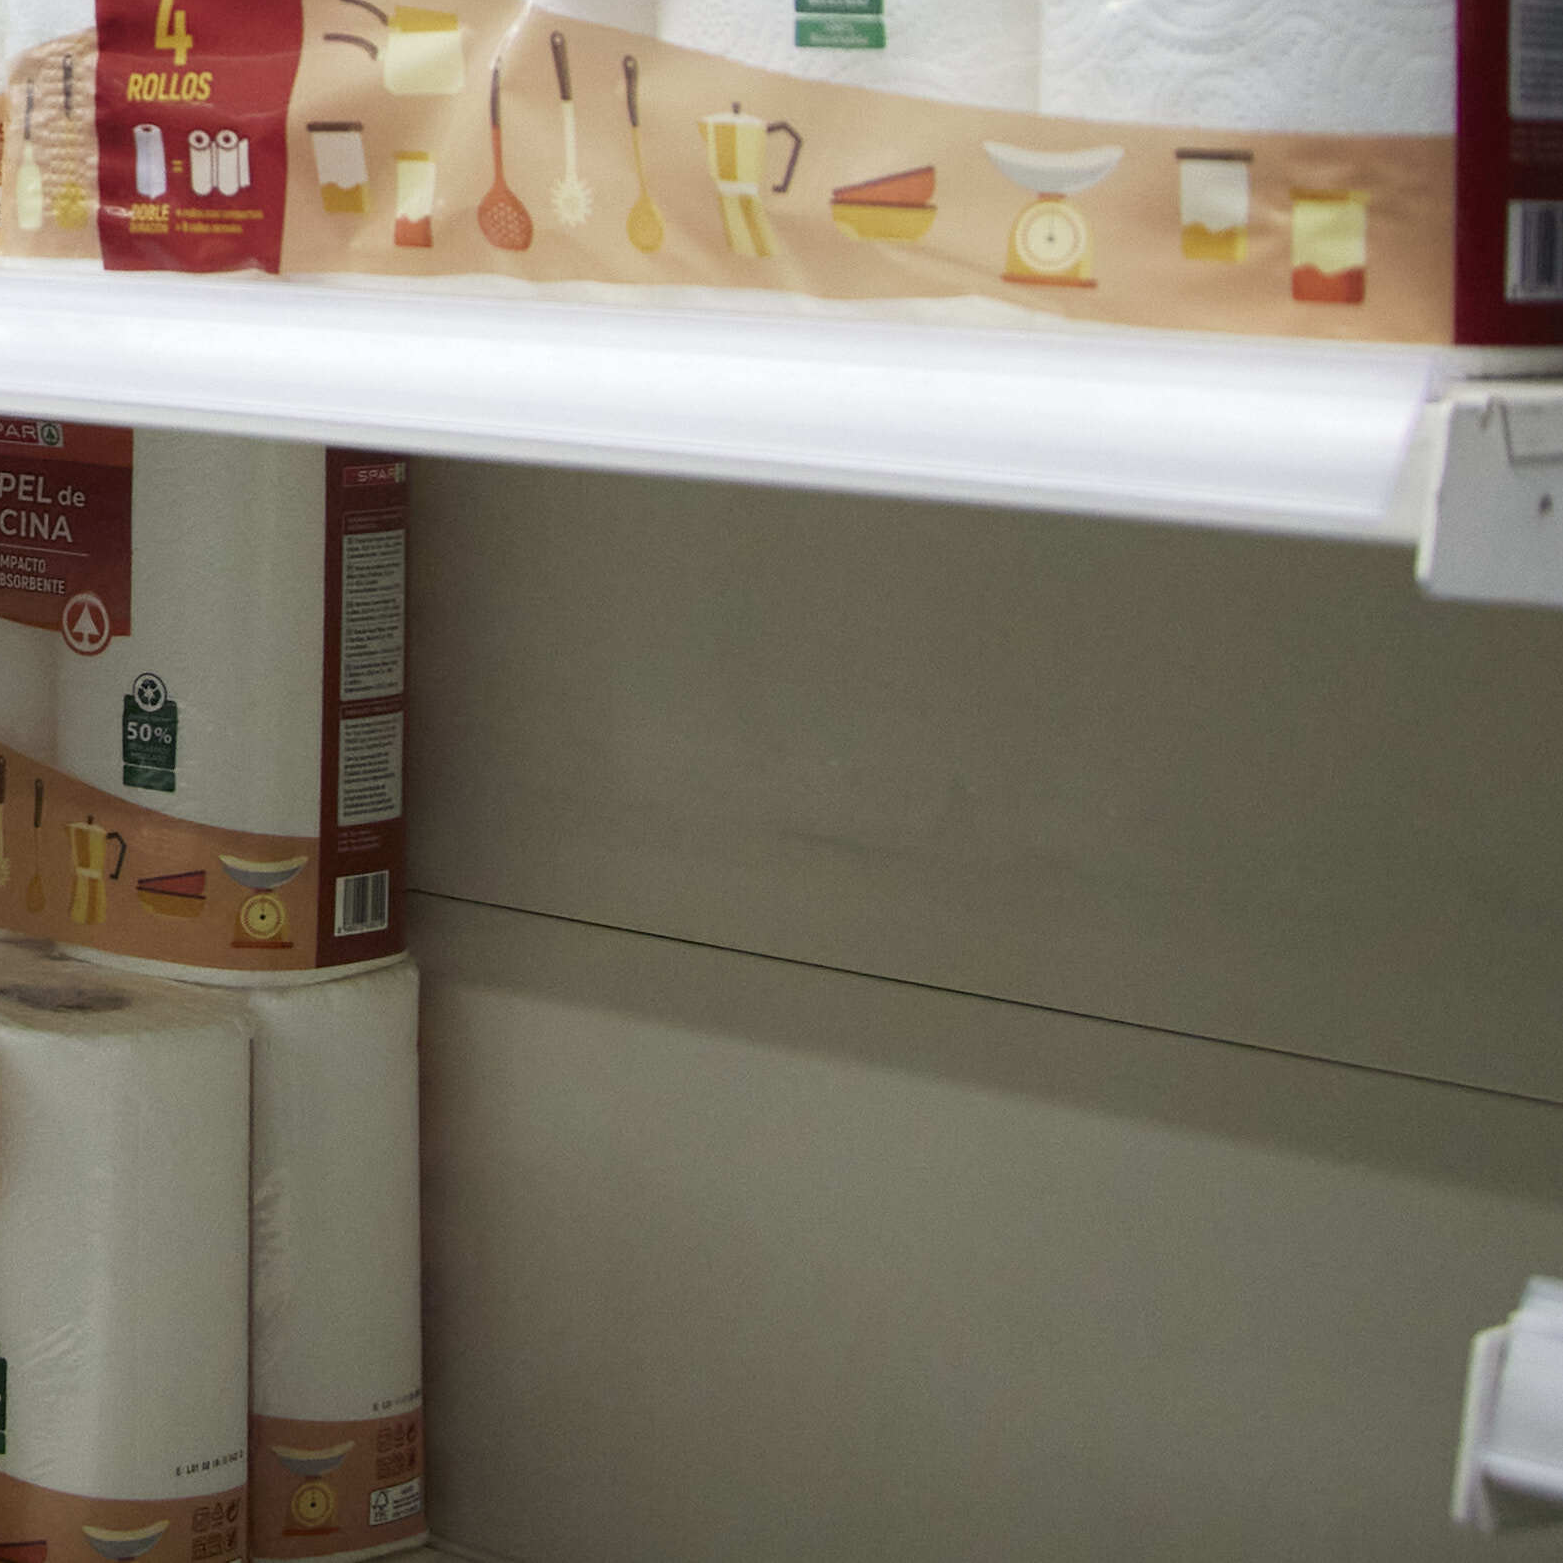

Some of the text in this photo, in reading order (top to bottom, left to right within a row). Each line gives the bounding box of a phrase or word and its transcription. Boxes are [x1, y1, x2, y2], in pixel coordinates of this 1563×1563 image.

[126, 71, 214, 103] ROLLOS
[57, 485, 86, 509] de
[126, 721, 172, 745] 50%
